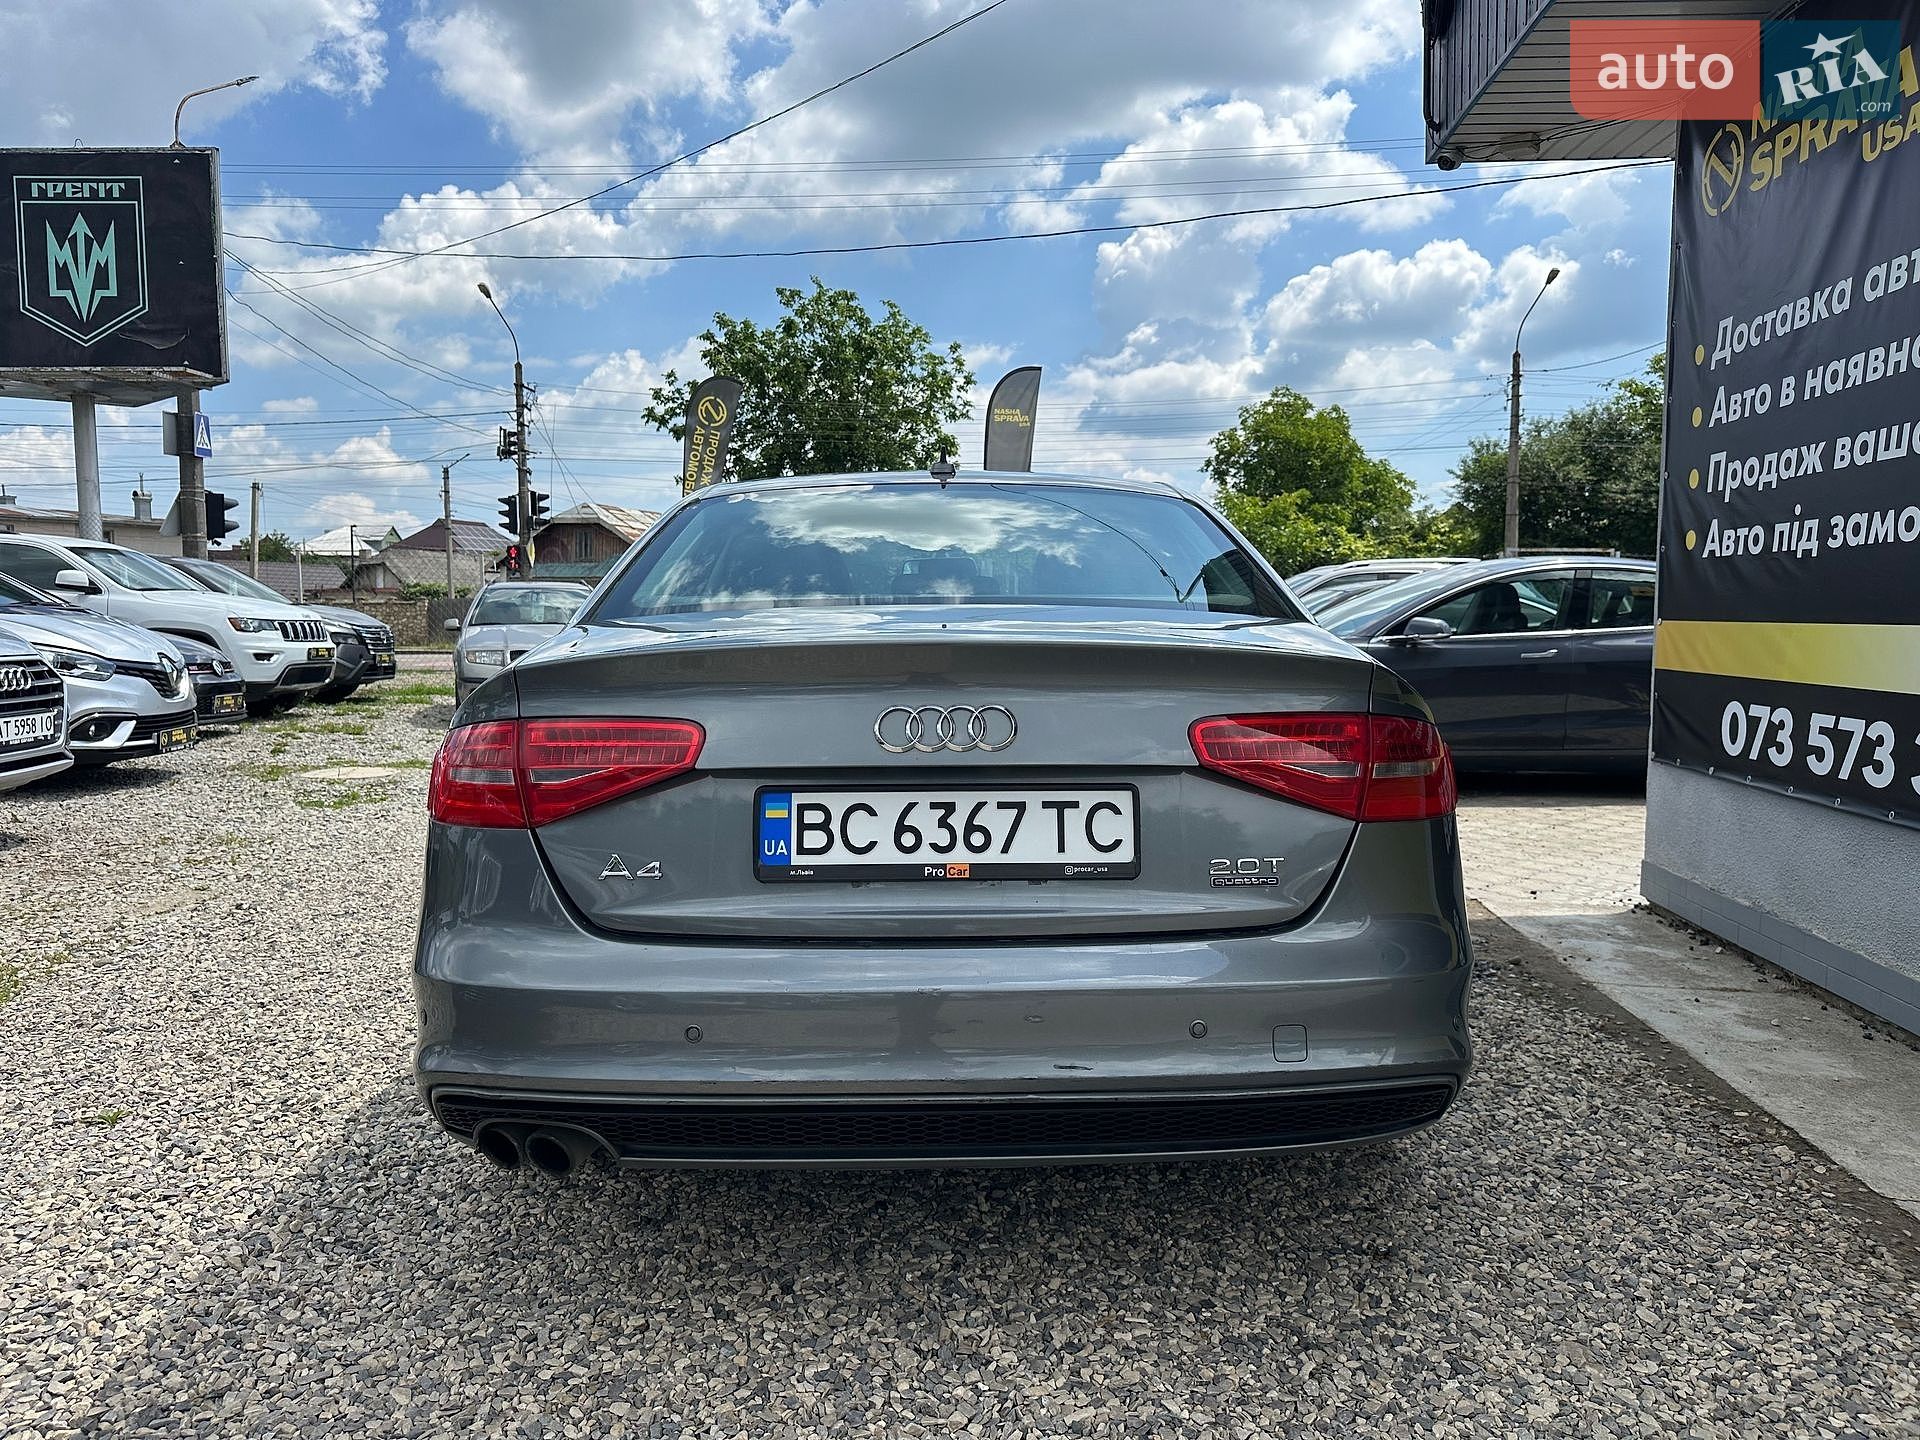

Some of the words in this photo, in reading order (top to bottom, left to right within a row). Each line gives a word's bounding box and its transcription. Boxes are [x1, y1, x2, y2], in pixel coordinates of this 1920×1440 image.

[1710, 277, 1853, 370] Доставка
[994, 414, 1029, 422] SPRAVA
[1709, 383, 1772, 428] Авто
[1779, 375, 1796, 409] в
[700, 429, 721, 486] ПРОДАЖ
[1706, 441, 1827, 503] Продаж
[1702, 518, 1765, 559] Авто
[1771, 503, 1819, 559] під
[14, 718, 37, 736] 5958
[1721, 700, 1794, 768] 073
[1806, 712, 1895, 789] 573
[764, 840, 788, 856] UA
[796, 802, 878, 856] BC
[893, 801, 1026, 855] 6367
[1042, 801, 1123, 855] TC
[599, 853, 662, 880] A4
[1209, 857, 1285, 875] 2.0T
[1214, 877, 1277, 887] quattro
